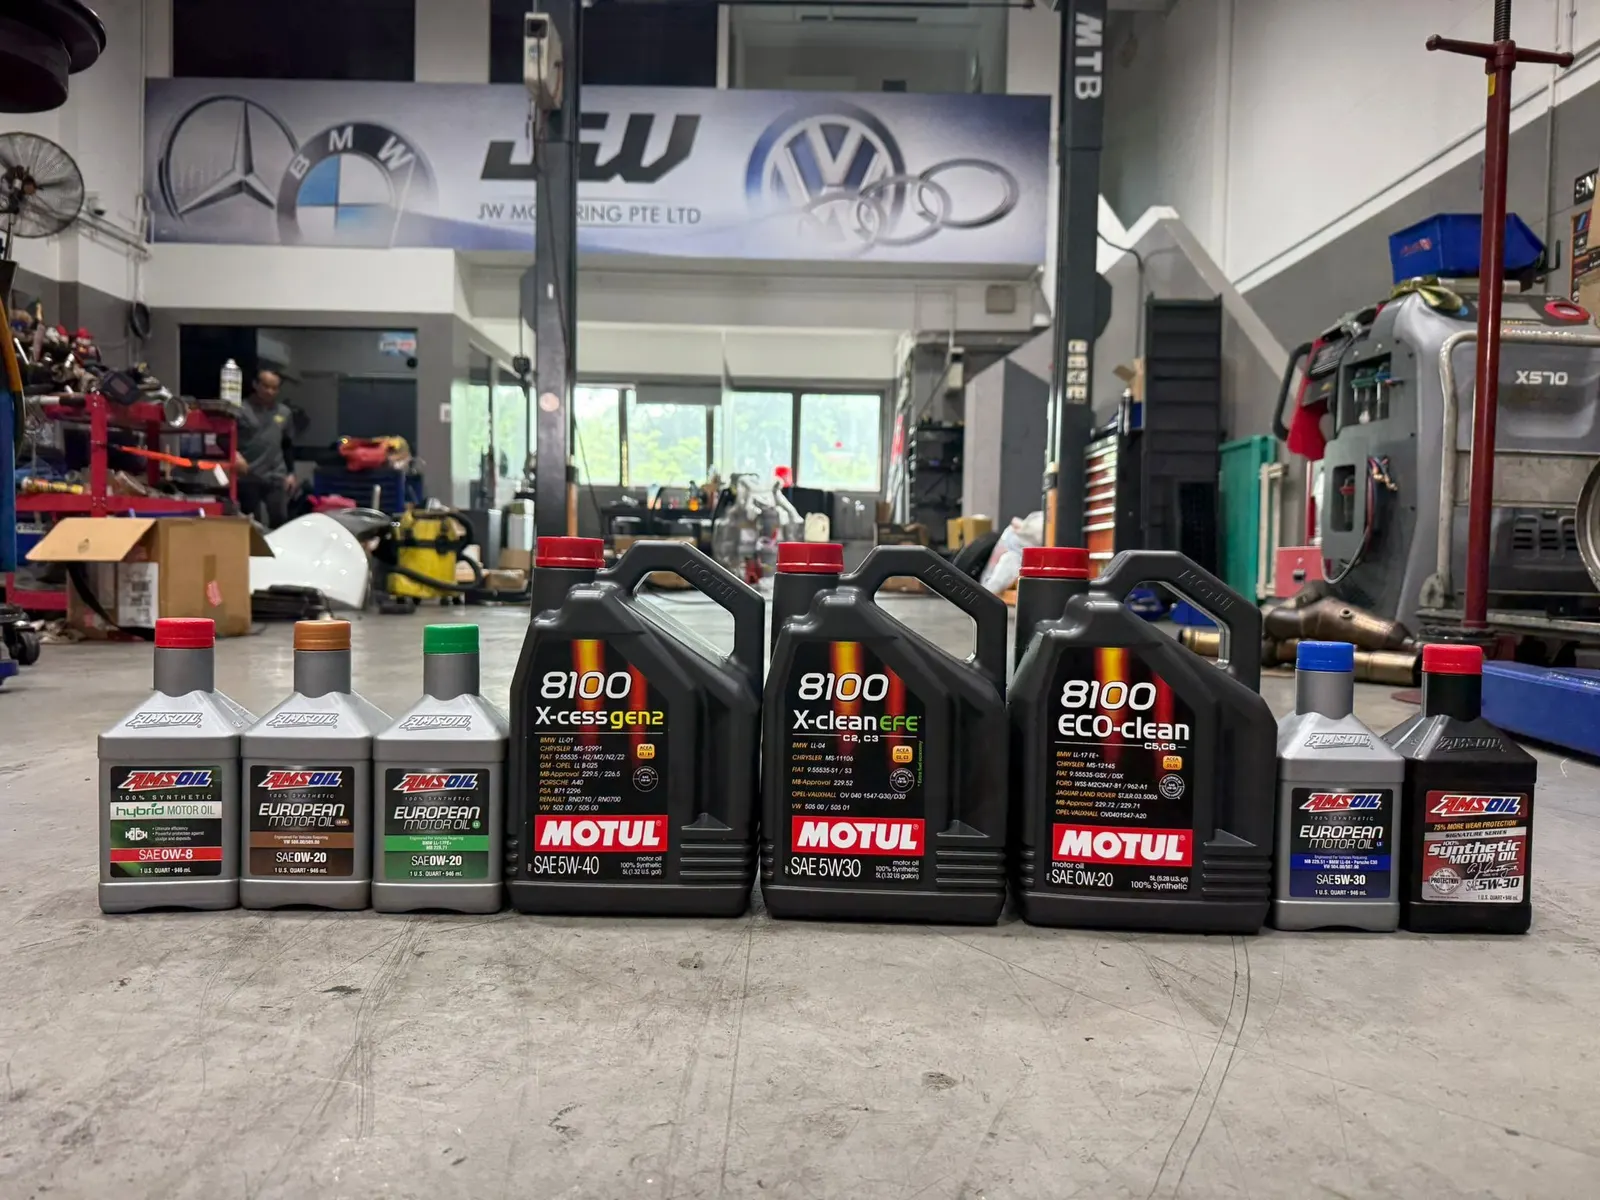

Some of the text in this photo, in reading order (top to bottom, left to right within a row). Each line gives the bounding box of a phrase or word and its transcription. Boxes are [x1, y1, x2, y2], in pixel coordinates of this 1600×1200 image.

[1075, 12, 1102, 99] MTB
[478, 204, 505, 219] JW
[629, 206, 661, 222] PTE
[667, 208, 700, 224] LTD
[1515, 370, 1568, 386] X570
[541, 671, 632, 699] 8100
[799, 672, 889, 701] 8100
[1061, 680, 1156, 710] 8100
[125, 712, 203, 729] AMSOIL
[266, 712, 339, 728] AMSOIL
[399, 715, 472, 731] AMSOIL
[535, 706, 664, 729] X-cess gen2
[793, 710, 877, 730] X-clean
[1058, 714, 1189, 740] ECO-clean
[843, 735, 860, 743] C2,
[118, 770, 212, 792] AMSOIL
[258, 770, 342, 790] AMSOIL
[393, 774, 478, 794] AMSOIL
[116, 803, 215, 817] hybrid MOTOR OIL
[259, 803, 344, 816] EUROPEAN
[1299, 793, 1382, 812] AMSOIL
[1430, 795, 1520, 816] AMSOIL
[394, 806, 480, 819] EUROPEAN
[268, 816, 335, 827] MOTOR OIL
[404, 819, 470, 830] MOTOR OIL
[1482, 820, 1516, 828] PROTECTION
[540, 821, 660, 846] MOTUL
[797, 821, 917, 850] MOTUL
[1300, 825, 1383, 838] EUROPEAN
[1058, 830, 1183, 861] MOTUL
[1309, 838, 1374, 849] MOTOR OIL
[1428, 840, 1521, 858] Synthetic
[139, 849, 193, 860] SAE 0W-8
[276, 852, 326, 863] SAE 0W-20
[412, 855, 462, 866] SAE 0W-20
[1449, 851, 1518, 864] MOTOR OIL
[534, 856, 556, 874] SAE
[558, 856, 599, 874] 5W-40
[791, 857, 816, 875] SAE
[819, 858, 861, 877] 5W30
[1052, 869, 1073, 884] SAE
[1076, 870, 1113, 887] 0W-20
[1131, 881, 1187, 890] 100% Synthetic
[1317, 874, 1366, 885] SAE 5W-30
[1466, 880, 1478, 891] SAE
[1478, 878, 1520, 890] 5W-30
